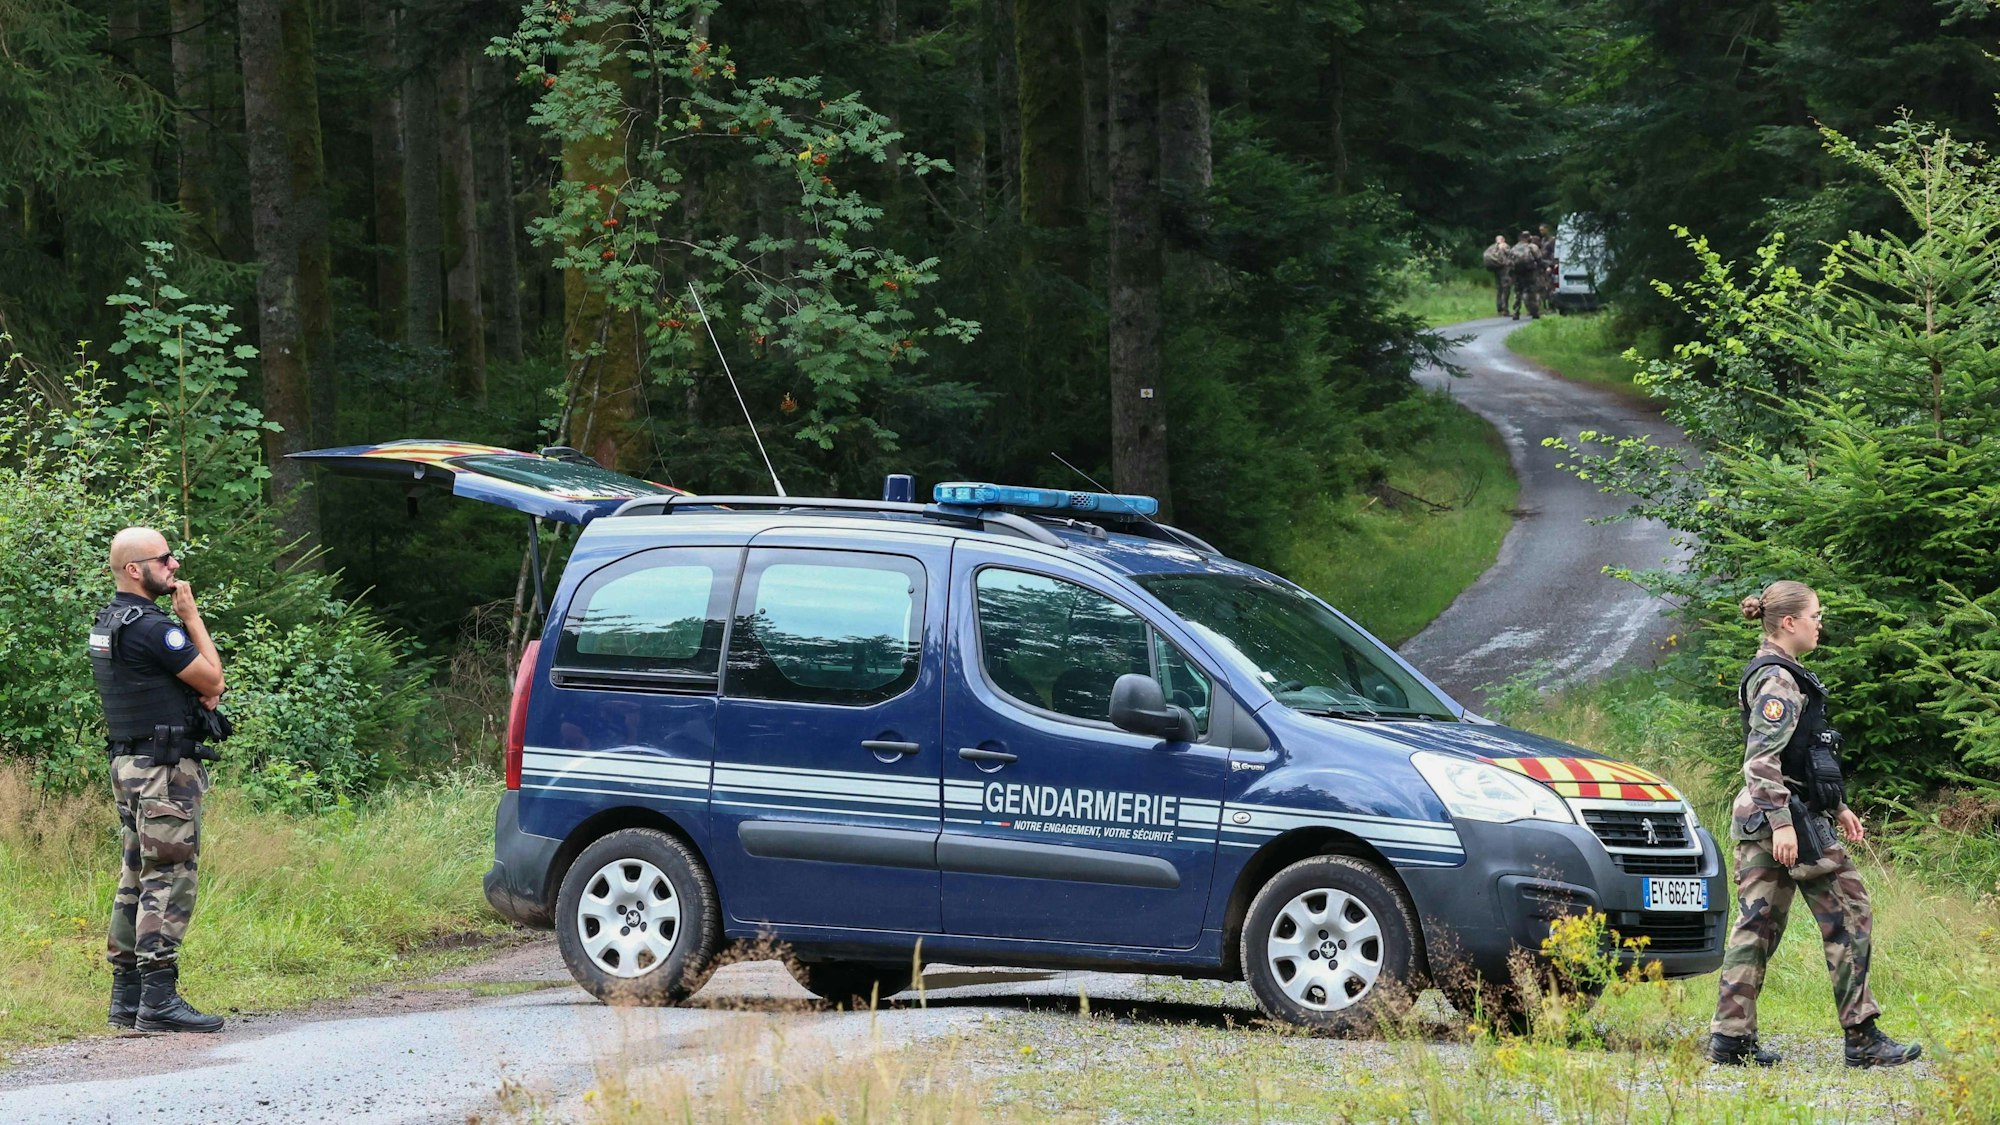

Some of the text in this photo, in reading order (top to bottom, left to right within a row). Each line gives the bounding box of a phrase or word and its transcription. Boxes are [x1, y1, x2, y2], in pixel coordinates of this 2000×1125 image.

[985, 781, 1177, 826] GENDARMERIE
[1013, 820, 1174, 842] NOTRE ENGAGEMENT, VOTRE SÉCURITÉ
[1651, 881, 1702, 905] EY-662-FZ
